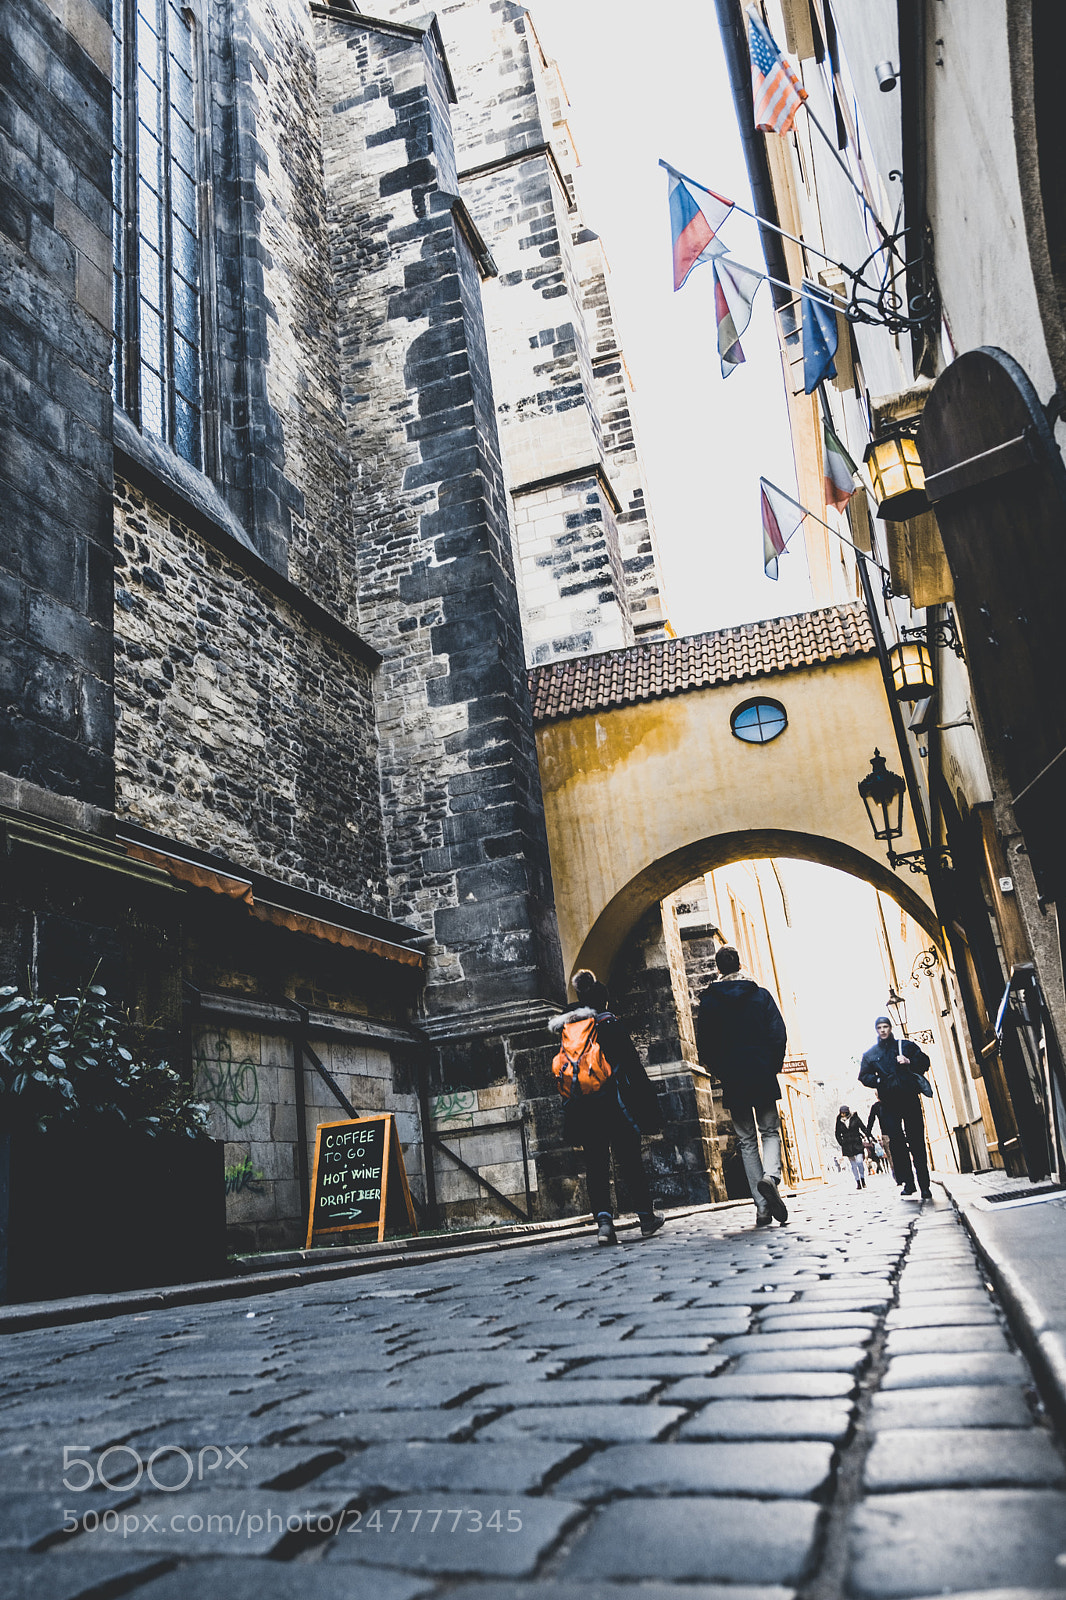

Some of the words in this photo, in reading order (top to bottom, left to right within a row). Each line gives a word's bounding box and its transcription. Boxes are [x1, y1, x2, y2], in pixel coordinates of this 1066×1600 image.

[326, 1129, 375, 1148] COFFEE
[324, 1152, 342, 1163] TO
[347, 1148, 365, 1159] GO
[323, 1170, 348, 1186] HOT
[320, 1190, 356, 1207] DRAFT
[356, 1188, 381, 1201] BEER
